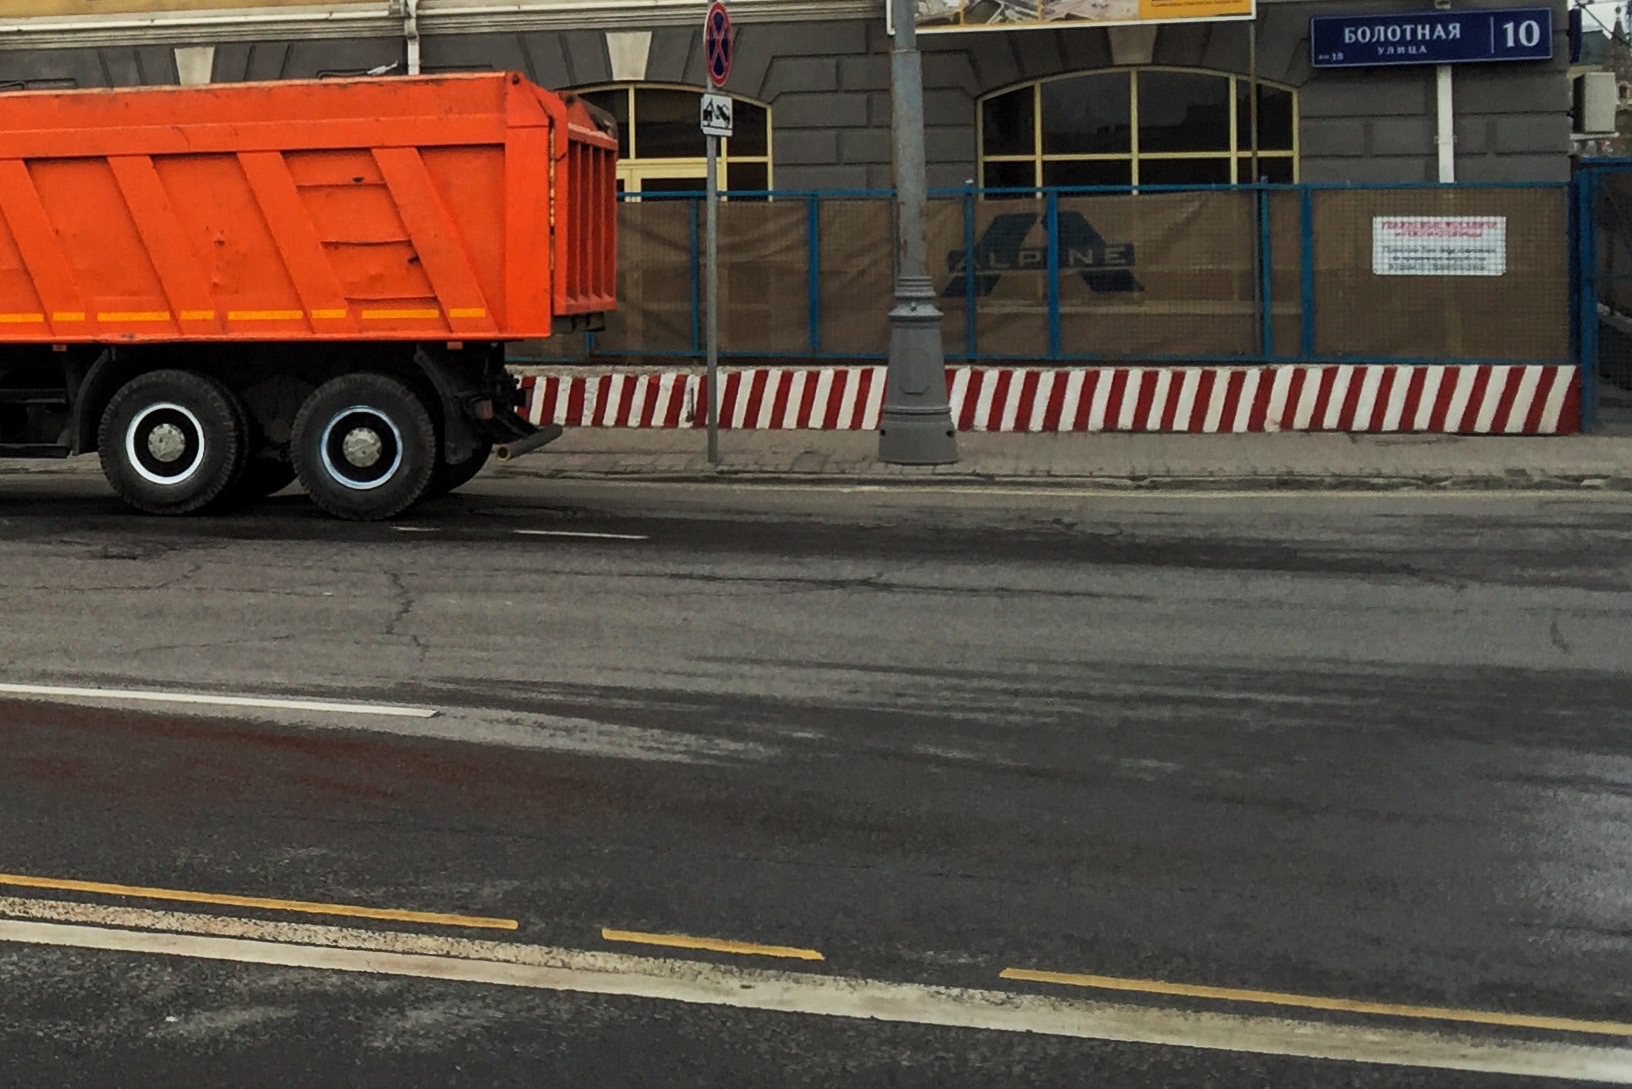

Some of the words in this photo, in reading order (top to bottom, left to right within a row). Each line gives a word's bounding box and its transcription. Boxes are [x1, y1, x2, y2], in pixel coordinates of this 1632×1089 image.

[1344, 23, 1462, 44] БОЛОТНАЯ
[1503, 20, 1541, 48] 10
[1377, 46, 1428, 56] УЛИЦА
[955, 247, 1127, 270] ALPNE
